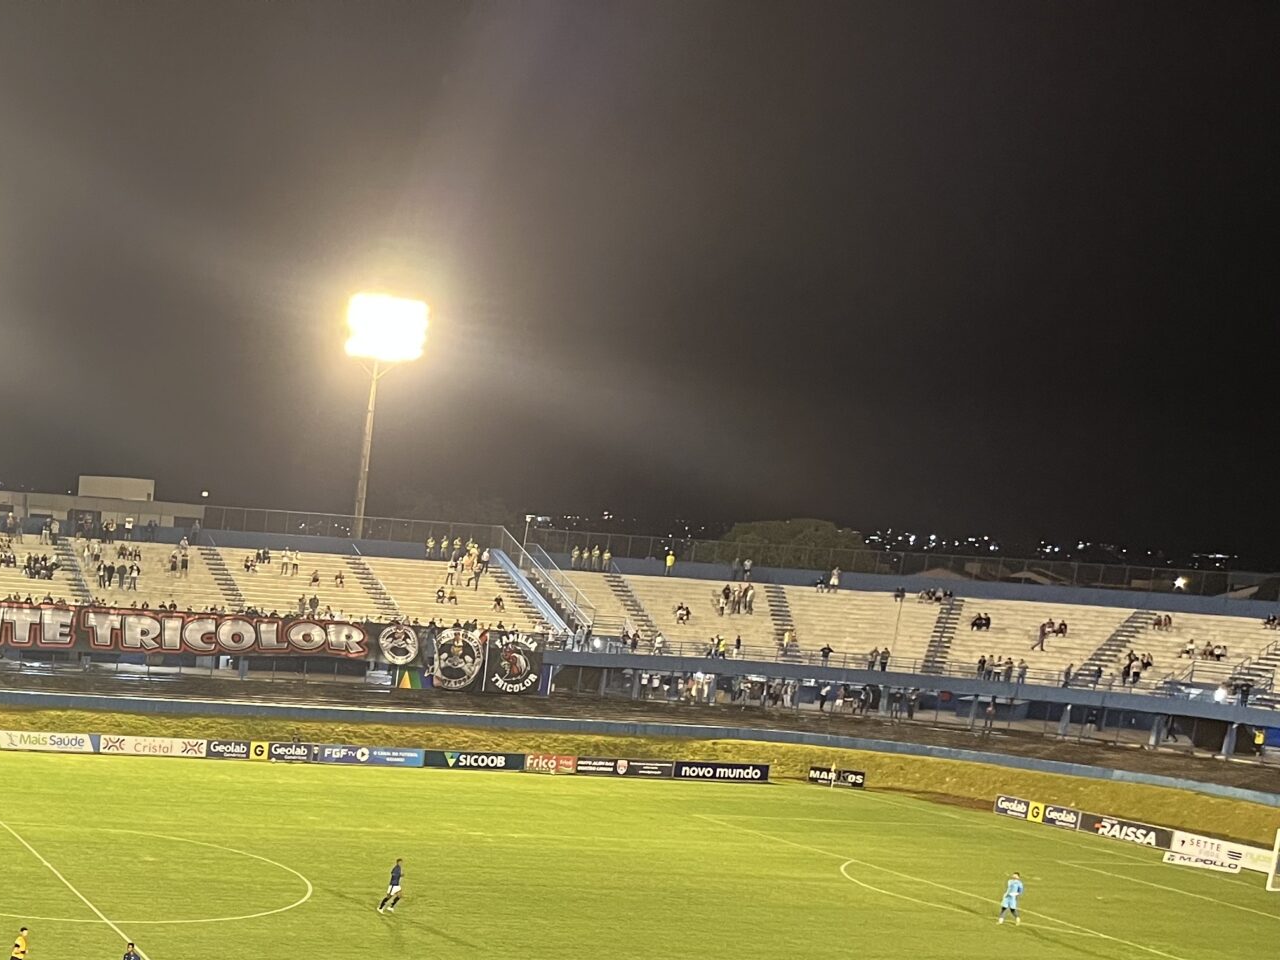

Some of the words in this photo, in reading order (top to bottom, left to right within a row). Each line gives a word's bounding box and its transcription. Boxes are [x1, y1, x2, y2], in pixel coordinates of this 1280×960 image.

[82, 605, 368, 657] TRICOLOR
[491, 673, 538, 692] TRICOLOR
[20, 734, 48, 745] Mais
[49, 735, 85, 747] Saúde
[210, 741, 247, 753] Geolab
[133, 742, 173, 754] Cristal
[254, 745, 264, 756] G
[271, 744, 308, 755] Geolab
[458, 755, 506, 768] SICOOB
[526, 755, 556, 769] Fricó
[681, 766, 713, 778] novo
[716, 767, 761, 780] mundo
[998, 797, 1027, 813] Geolab
[1031, 806, 1040, 818] G
[1045, 807, 1077, 823] Geolab
[1098, 821, 1156, 846] RAISSA
[1189, 838, 1221, 851] SETTE
